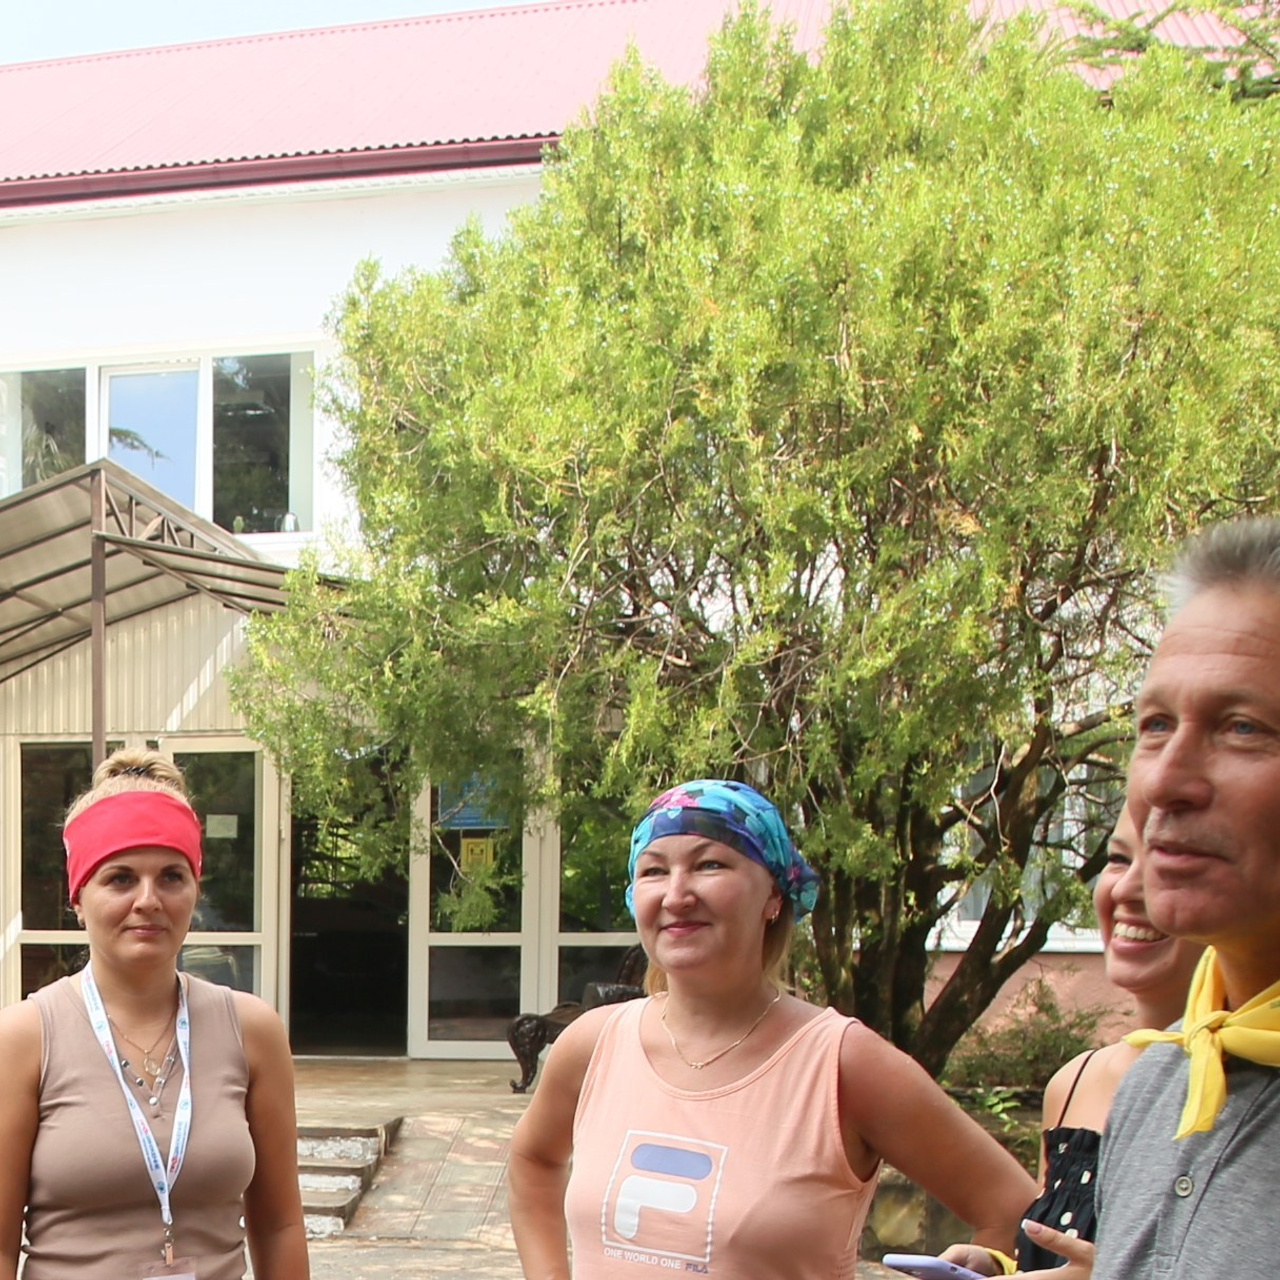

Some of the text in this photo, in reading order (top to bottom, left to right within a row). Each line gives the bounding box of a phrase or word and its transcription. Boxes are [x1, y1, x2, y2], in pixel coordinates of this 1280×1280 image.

[603, 1247, 709, 1274] ONE WORLD ONE FILA
